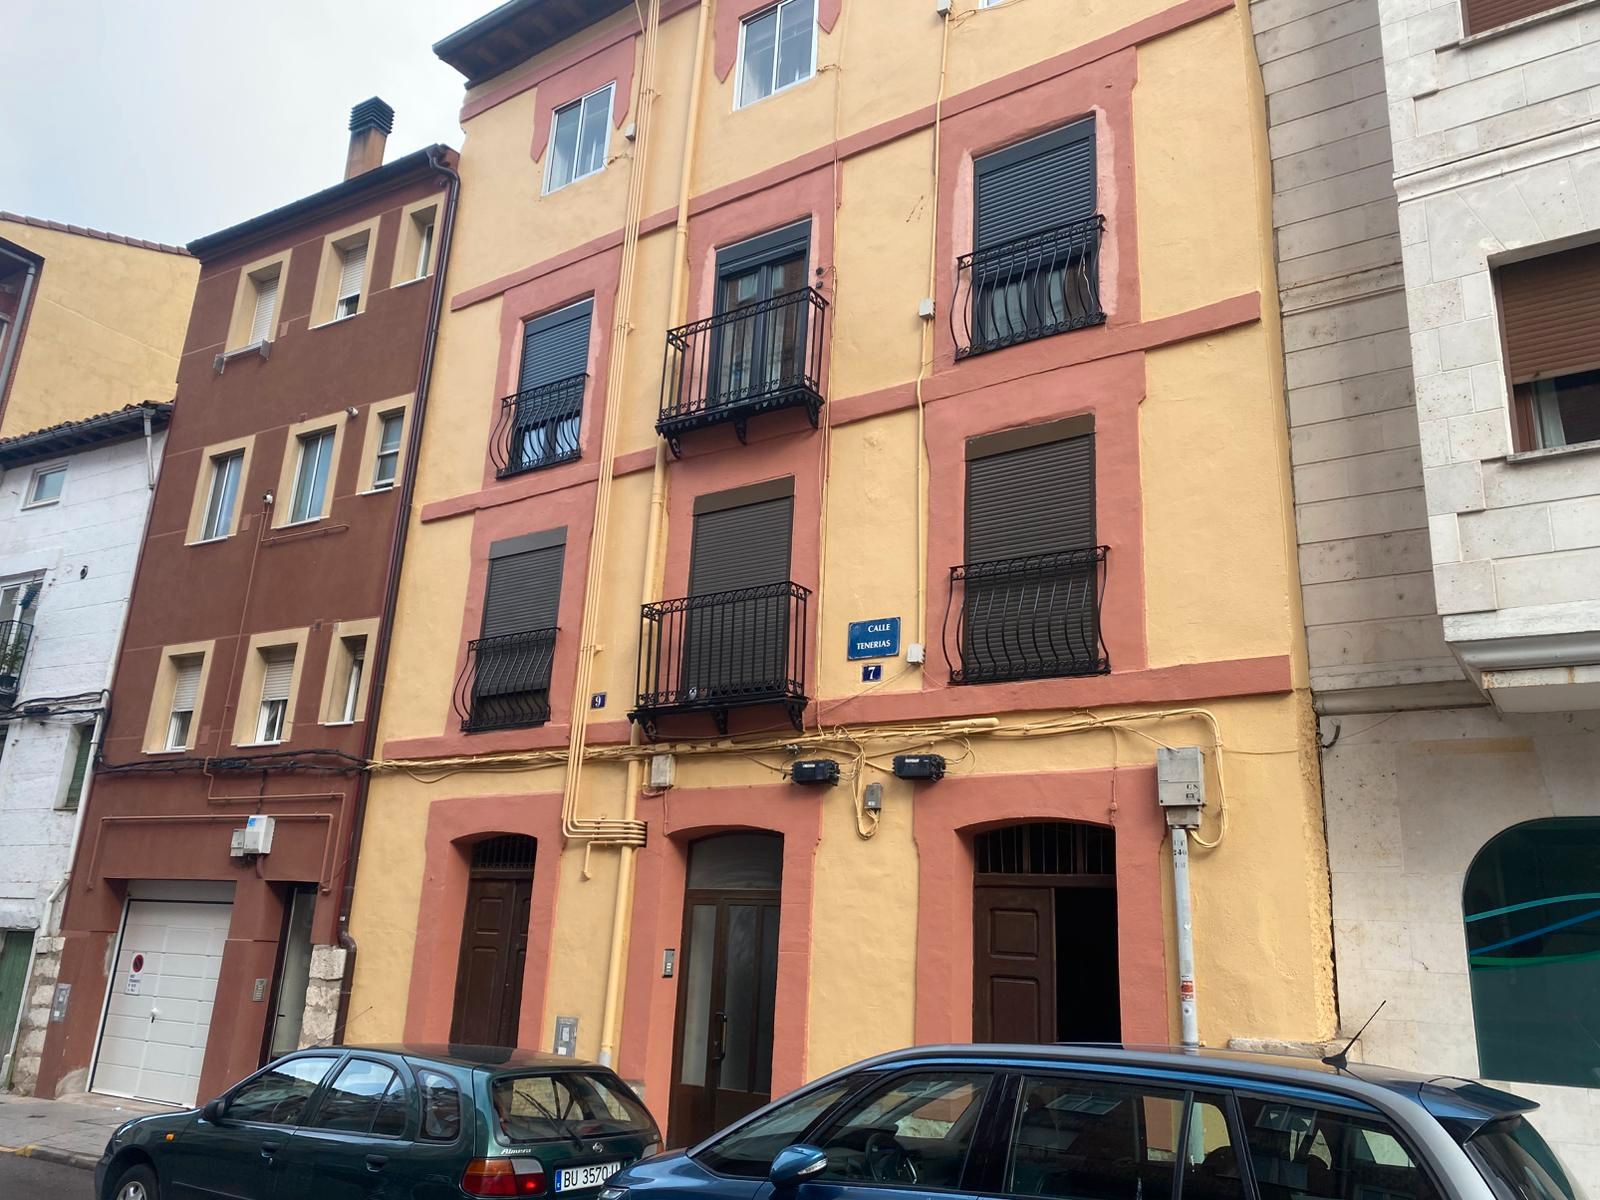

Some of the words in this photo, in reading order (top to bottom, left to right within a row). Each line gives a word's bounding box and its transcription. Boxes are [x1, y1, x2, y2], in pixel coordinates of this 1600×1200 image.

[868, 624, 891, 633] CALLE
[856, 639, 891, 650] TENERIAS
[868, 666, 876, 680] 7
[595, 695, 602, 708] 9
[564, 1170, 579, 1188] BU
[582, 1166, 609, 1184] 3570
